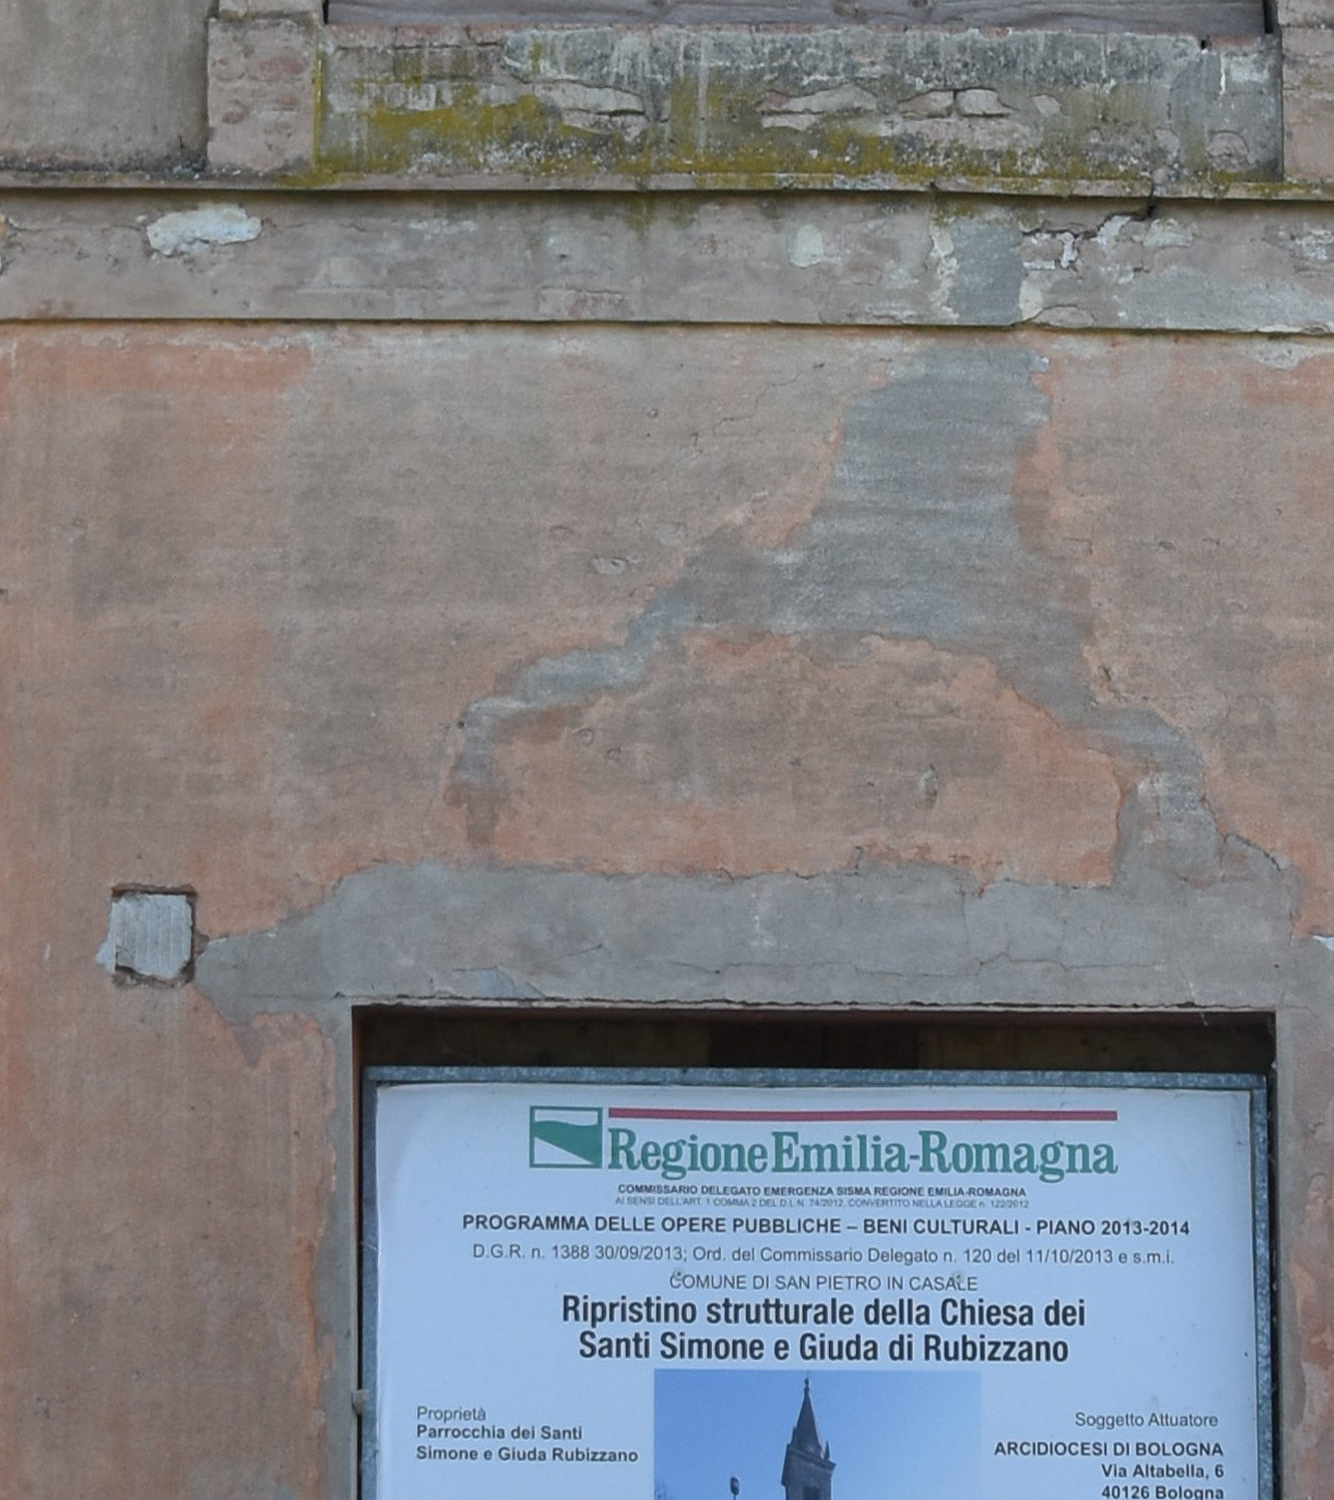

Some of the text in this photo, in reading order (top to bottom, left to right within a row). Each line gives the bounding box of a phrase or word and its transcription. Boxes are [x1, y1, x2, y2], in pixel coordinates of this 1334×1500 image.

[607, 1128, 1118, 1183] Regione Emilia-Romagna
[618, 1184, 1026, 1197] COMMISSARIO DELEGATO EMERGENZA SISMA REGIONE EMILIA-ROMAGNA
[463, 1215, 1189, 1236] PROGRAMMA DELLE OPERE PUBBLICHE BENI CULTURALI PIANO 2013-2014
[473, 1243, 1173, 1267] D.G.R. n. 1388 30/09/2013; Ord. del Commissario Delegato n. 120 del 11/10/2013 e s.m.i.
[669, 1274, 977, 1291] COMUNE DI SAN PIETRO IN CASALE
[563, 1295, 1085, 1327] Ripristino strutturale della Chiesa dei
[579, 1331, 1068, 1362] Santi Simone e Giuda di Rubizzano
[417, 1407, 486, 1424] Proprietà
[1075, 1412, 1218, 1431] Soggetto Attuatore
[417, 1424, 582, 1440] Parrocchia dei Santi
[416, 1445, 638, 1462] Simone e Giuda Rubizzano
[994, 1441, 1224, 1457] ARCIDIOCESI DI BOLOGNA
[1101, 1463, 1224, 1480] Via Altabella, 6
[1101, 1485, 1150, 1500] 40126
